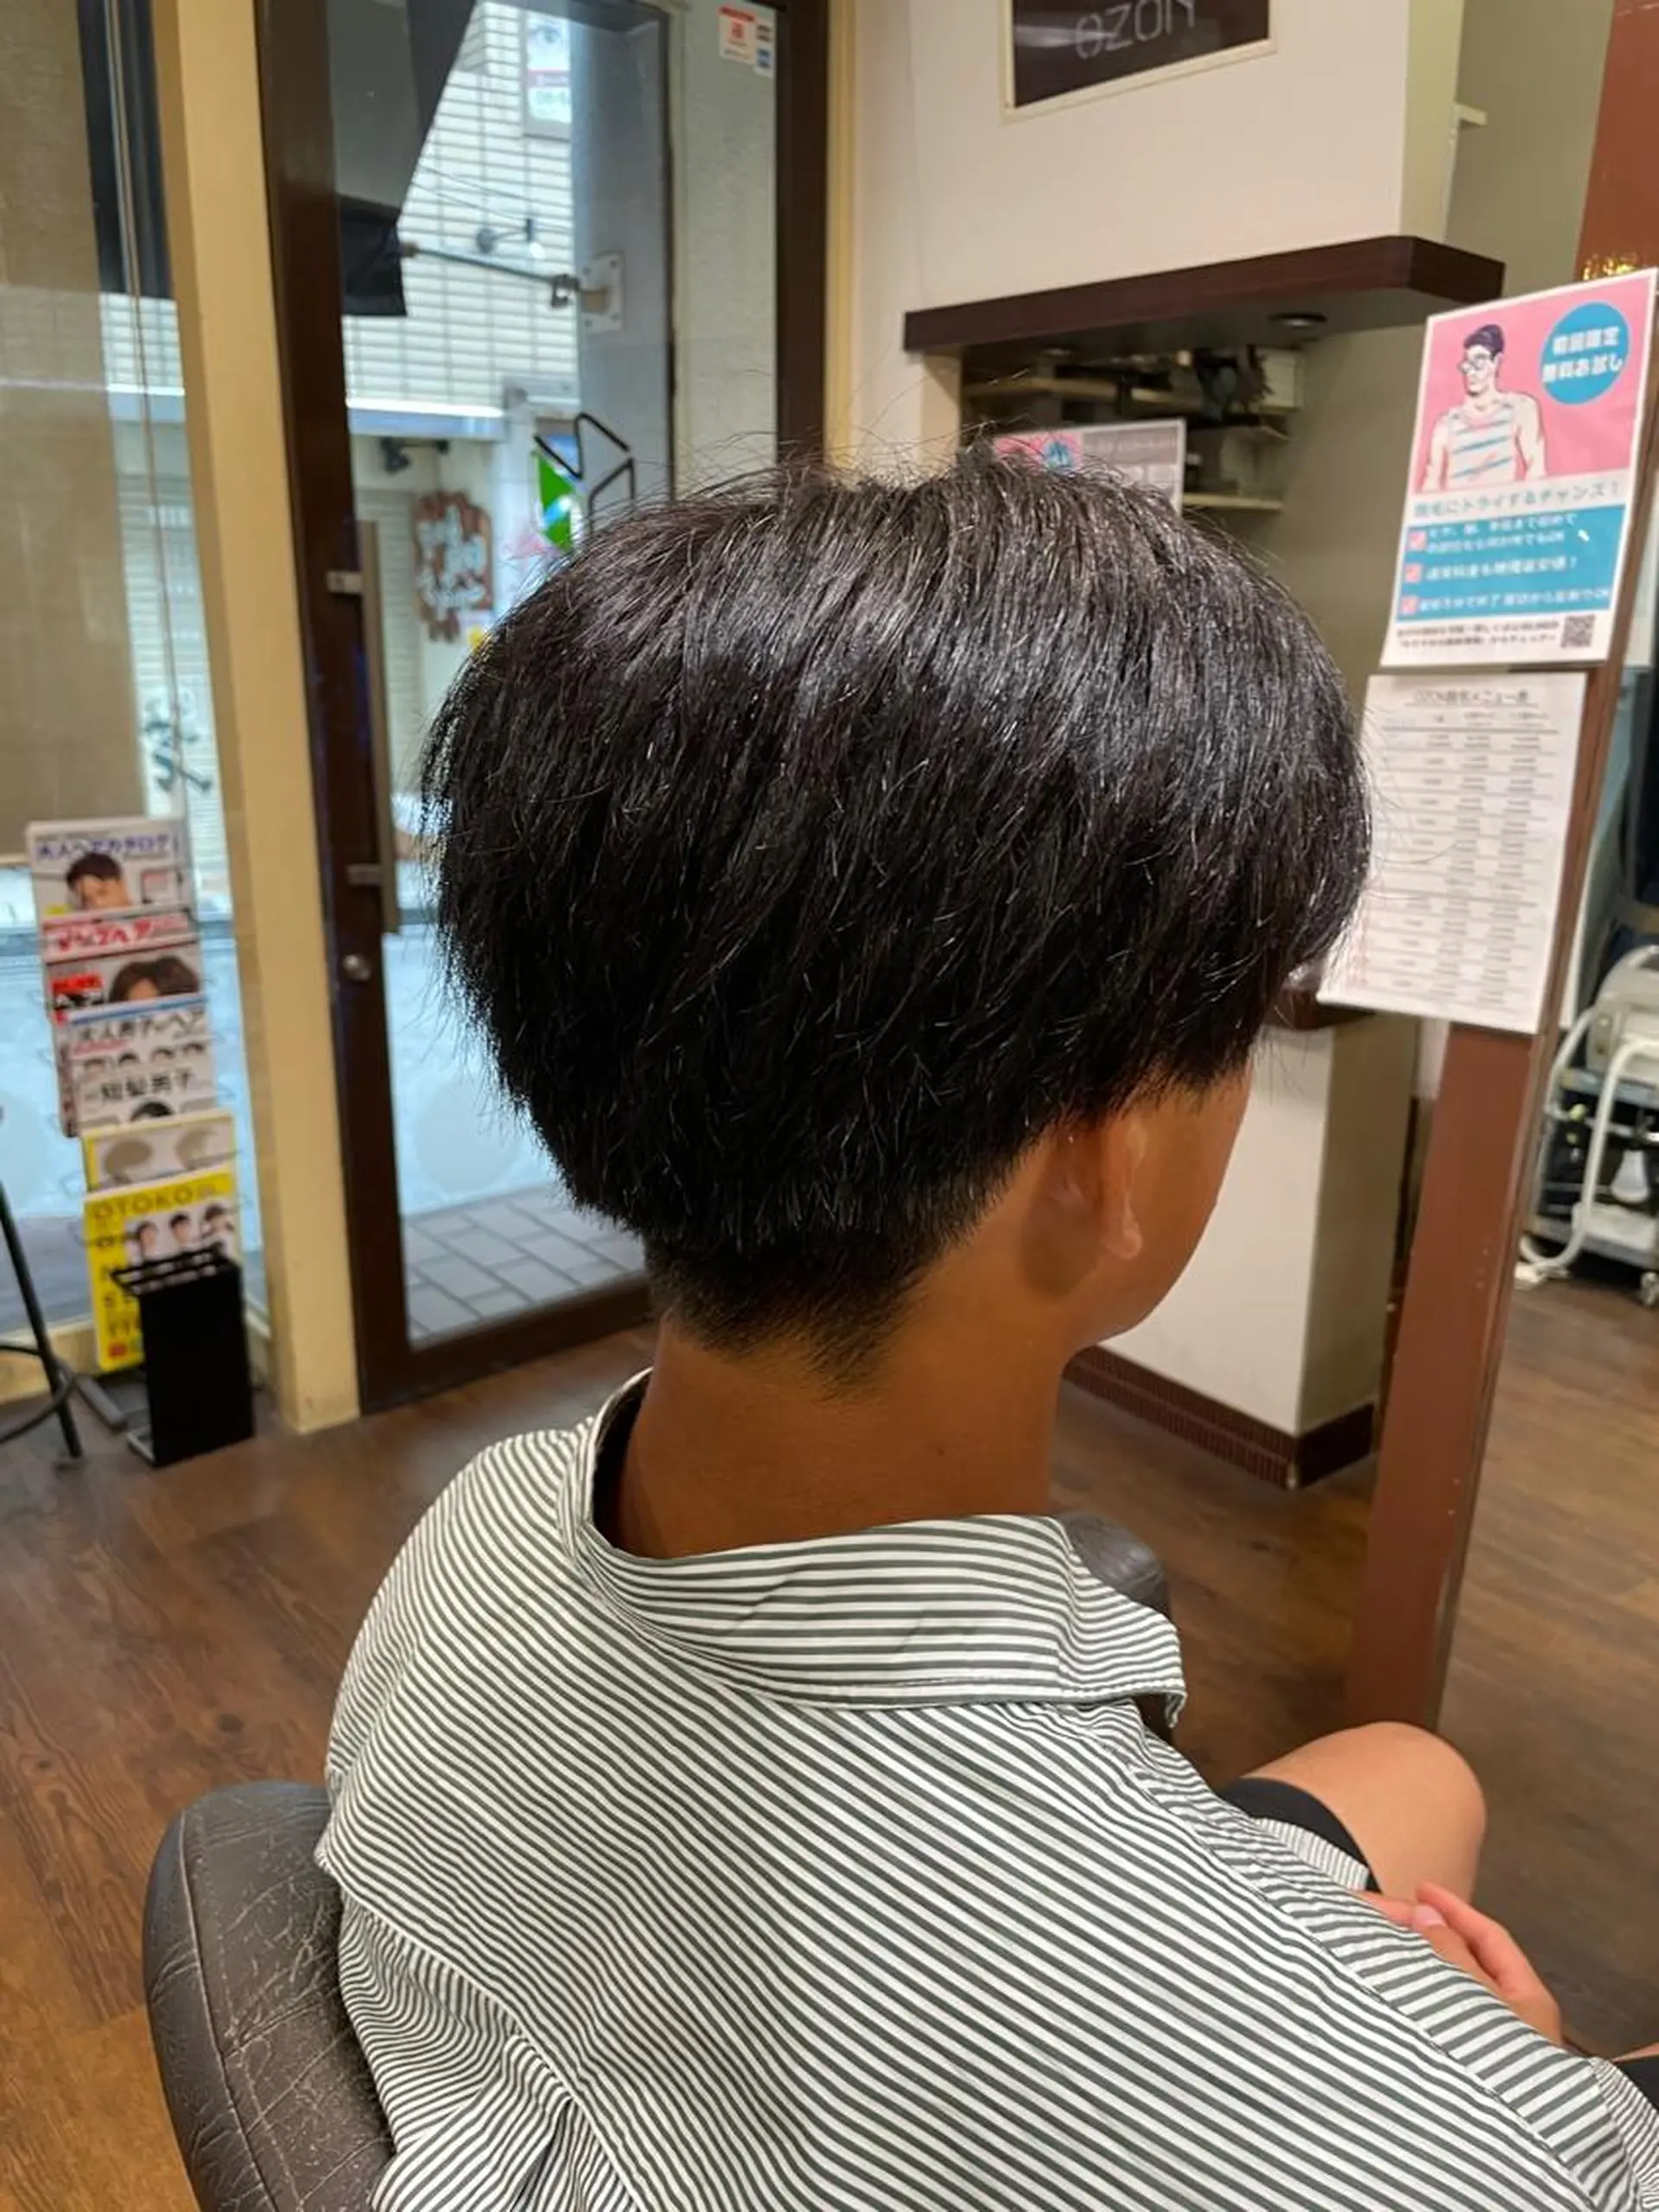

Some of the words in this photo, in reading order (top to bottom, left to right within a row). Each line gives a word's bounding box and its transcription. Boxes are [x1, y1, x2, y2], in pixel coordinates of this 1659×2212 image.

[1541, 353, 1624, 383] 無料お試し
